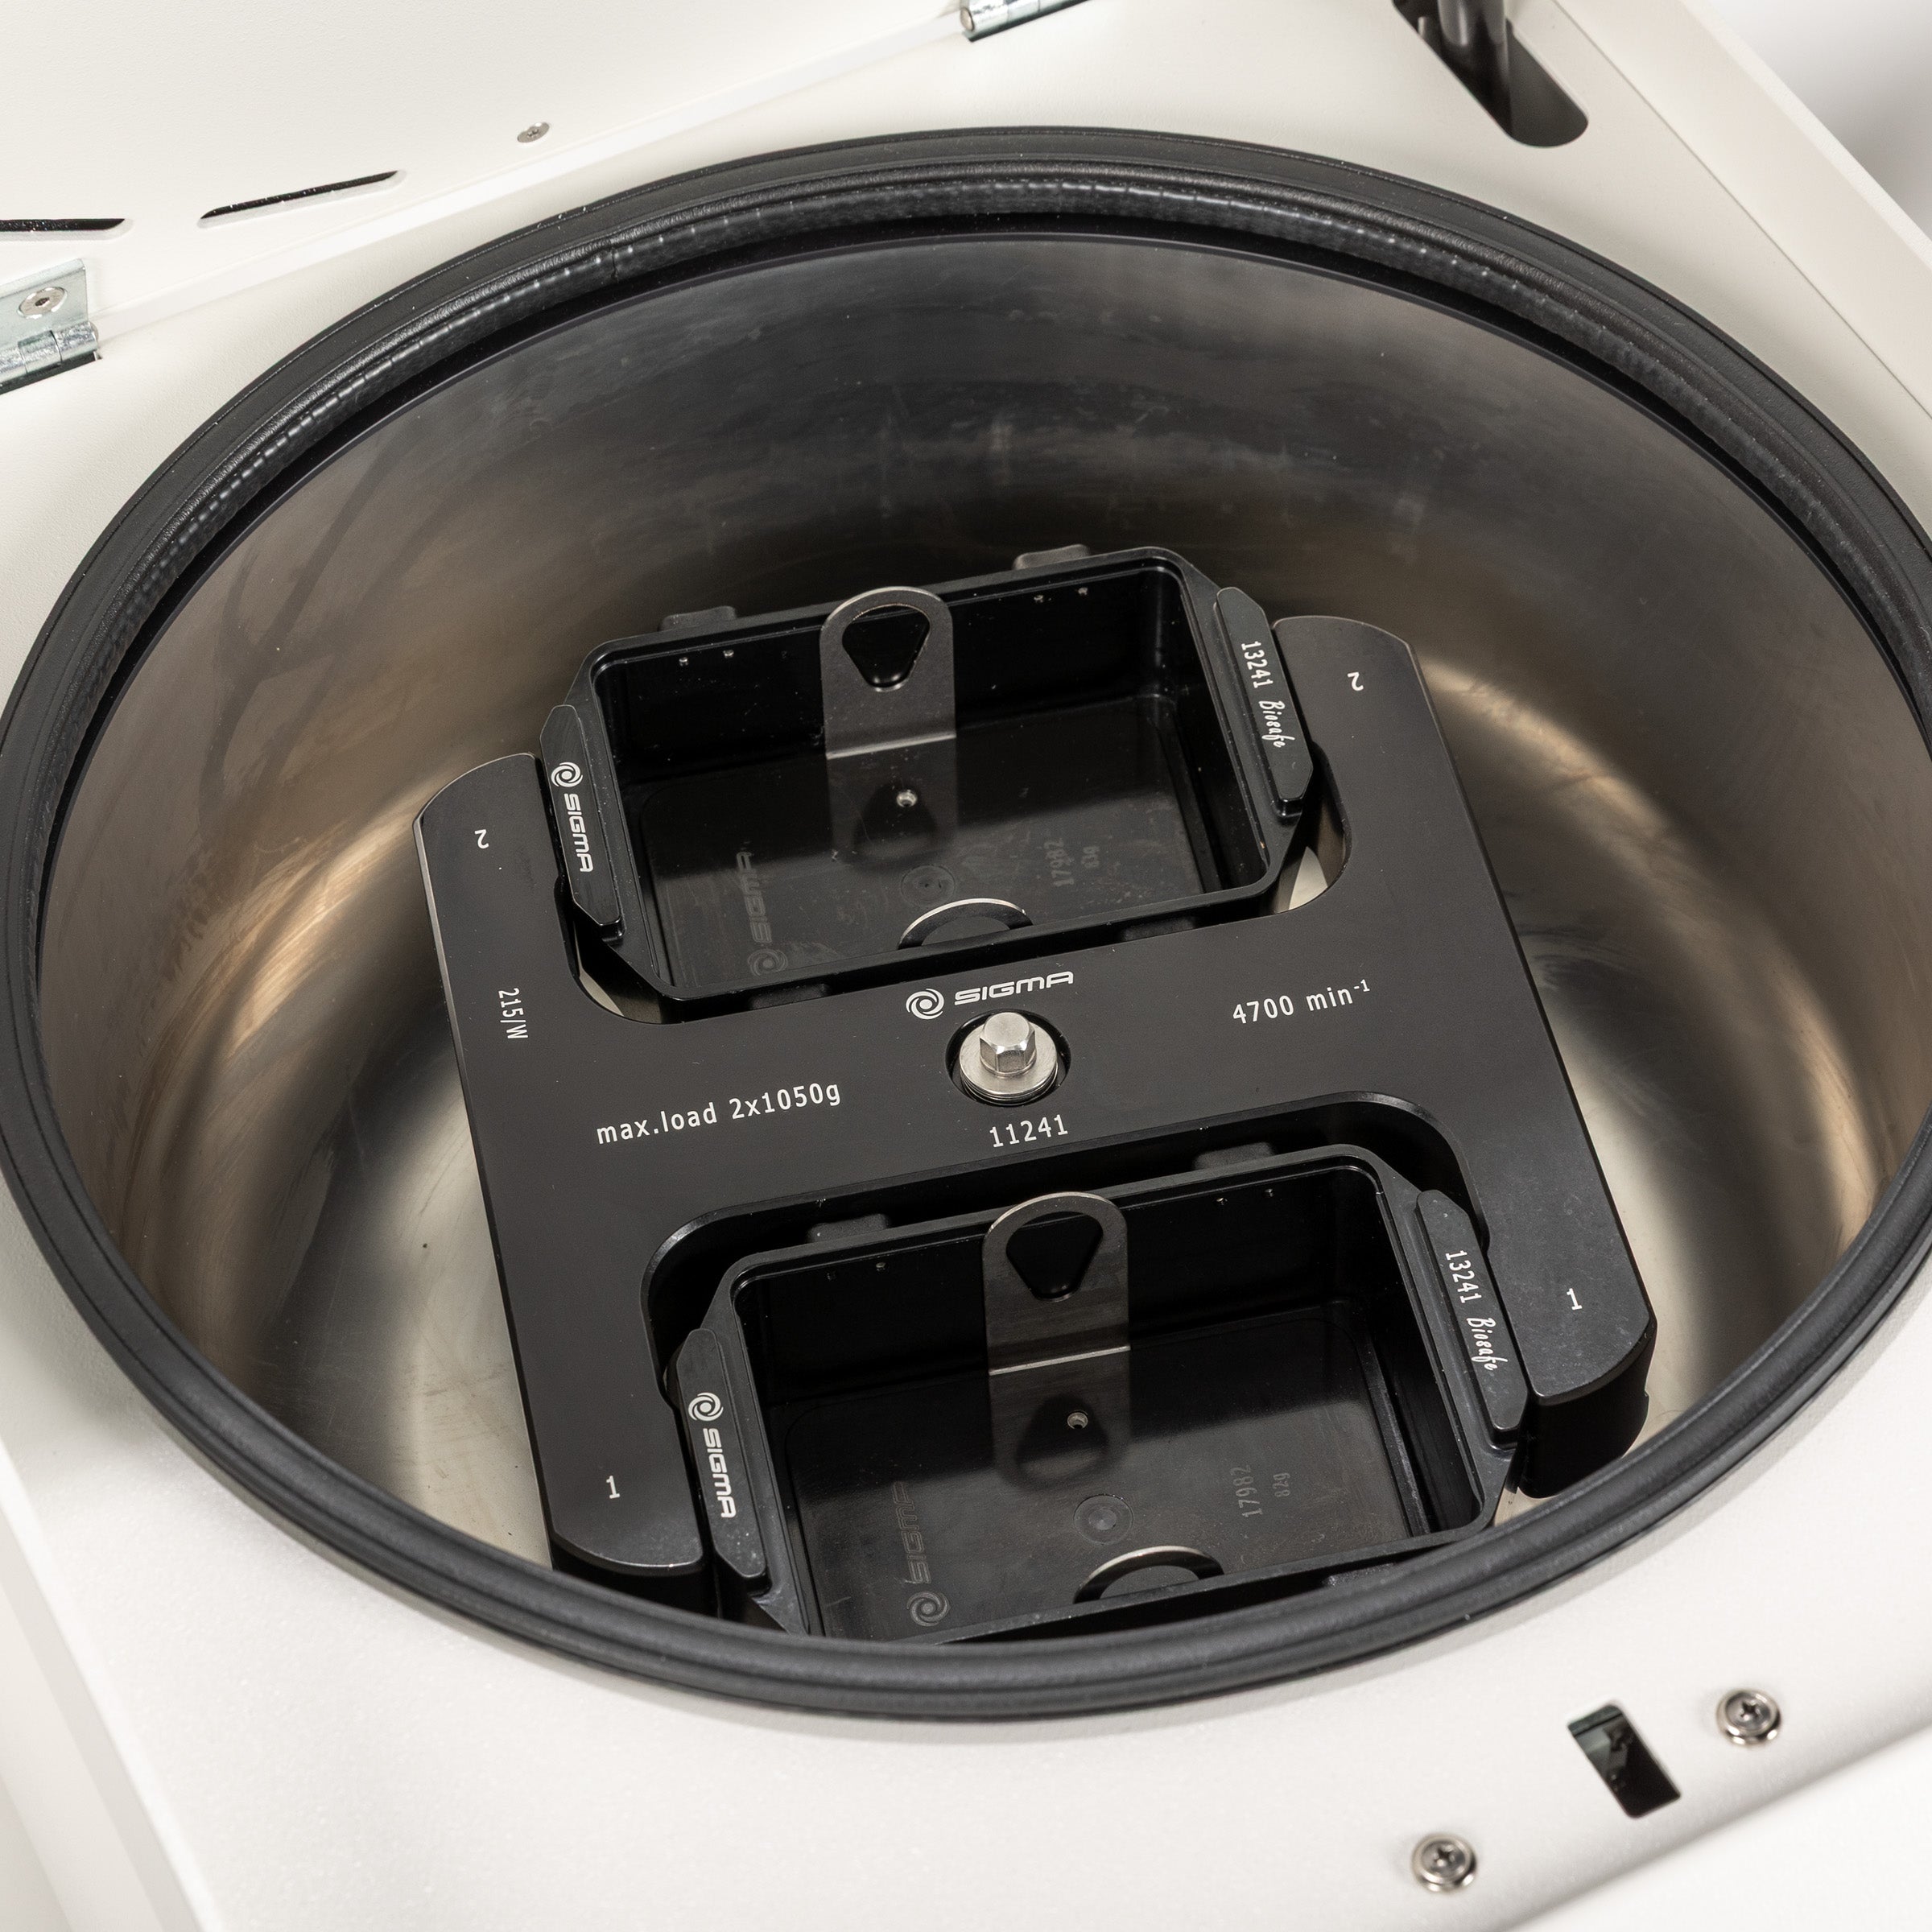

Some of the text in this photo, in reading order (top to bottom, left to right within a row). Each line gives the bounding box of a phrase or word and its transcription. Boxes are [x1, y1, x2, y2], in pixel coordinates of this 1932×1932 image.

[1241, 640, 1296, 749] 13241 Biosafe
[1346, 671, 1364, 691] 2
[474, 828, 489, 849] 2
[564, 792, 594, 873] SIGMA
[736, 851, 773, 943] SIGMA
[497, 987, 529, 1039] 215/W
[954, 970, 1074, 1006] SIGMA
[1232, 994, 1295, 1025] 4700
[597, 1081, 842, 1146] max.load 2x1050g
[989, 1113, 1069, 1149] 11241
[1445, 1249, 1509, 1372] 13241 Biosafe
[1566, 1286, 1583, 1311] 1
[605, 1475, 621, 1501] 1
[702, 1426, 737, 1519] SIGMA
[1229, 1465, 1263, 1517] 17982
[891, 1478, 932, 1584] SIGMA
